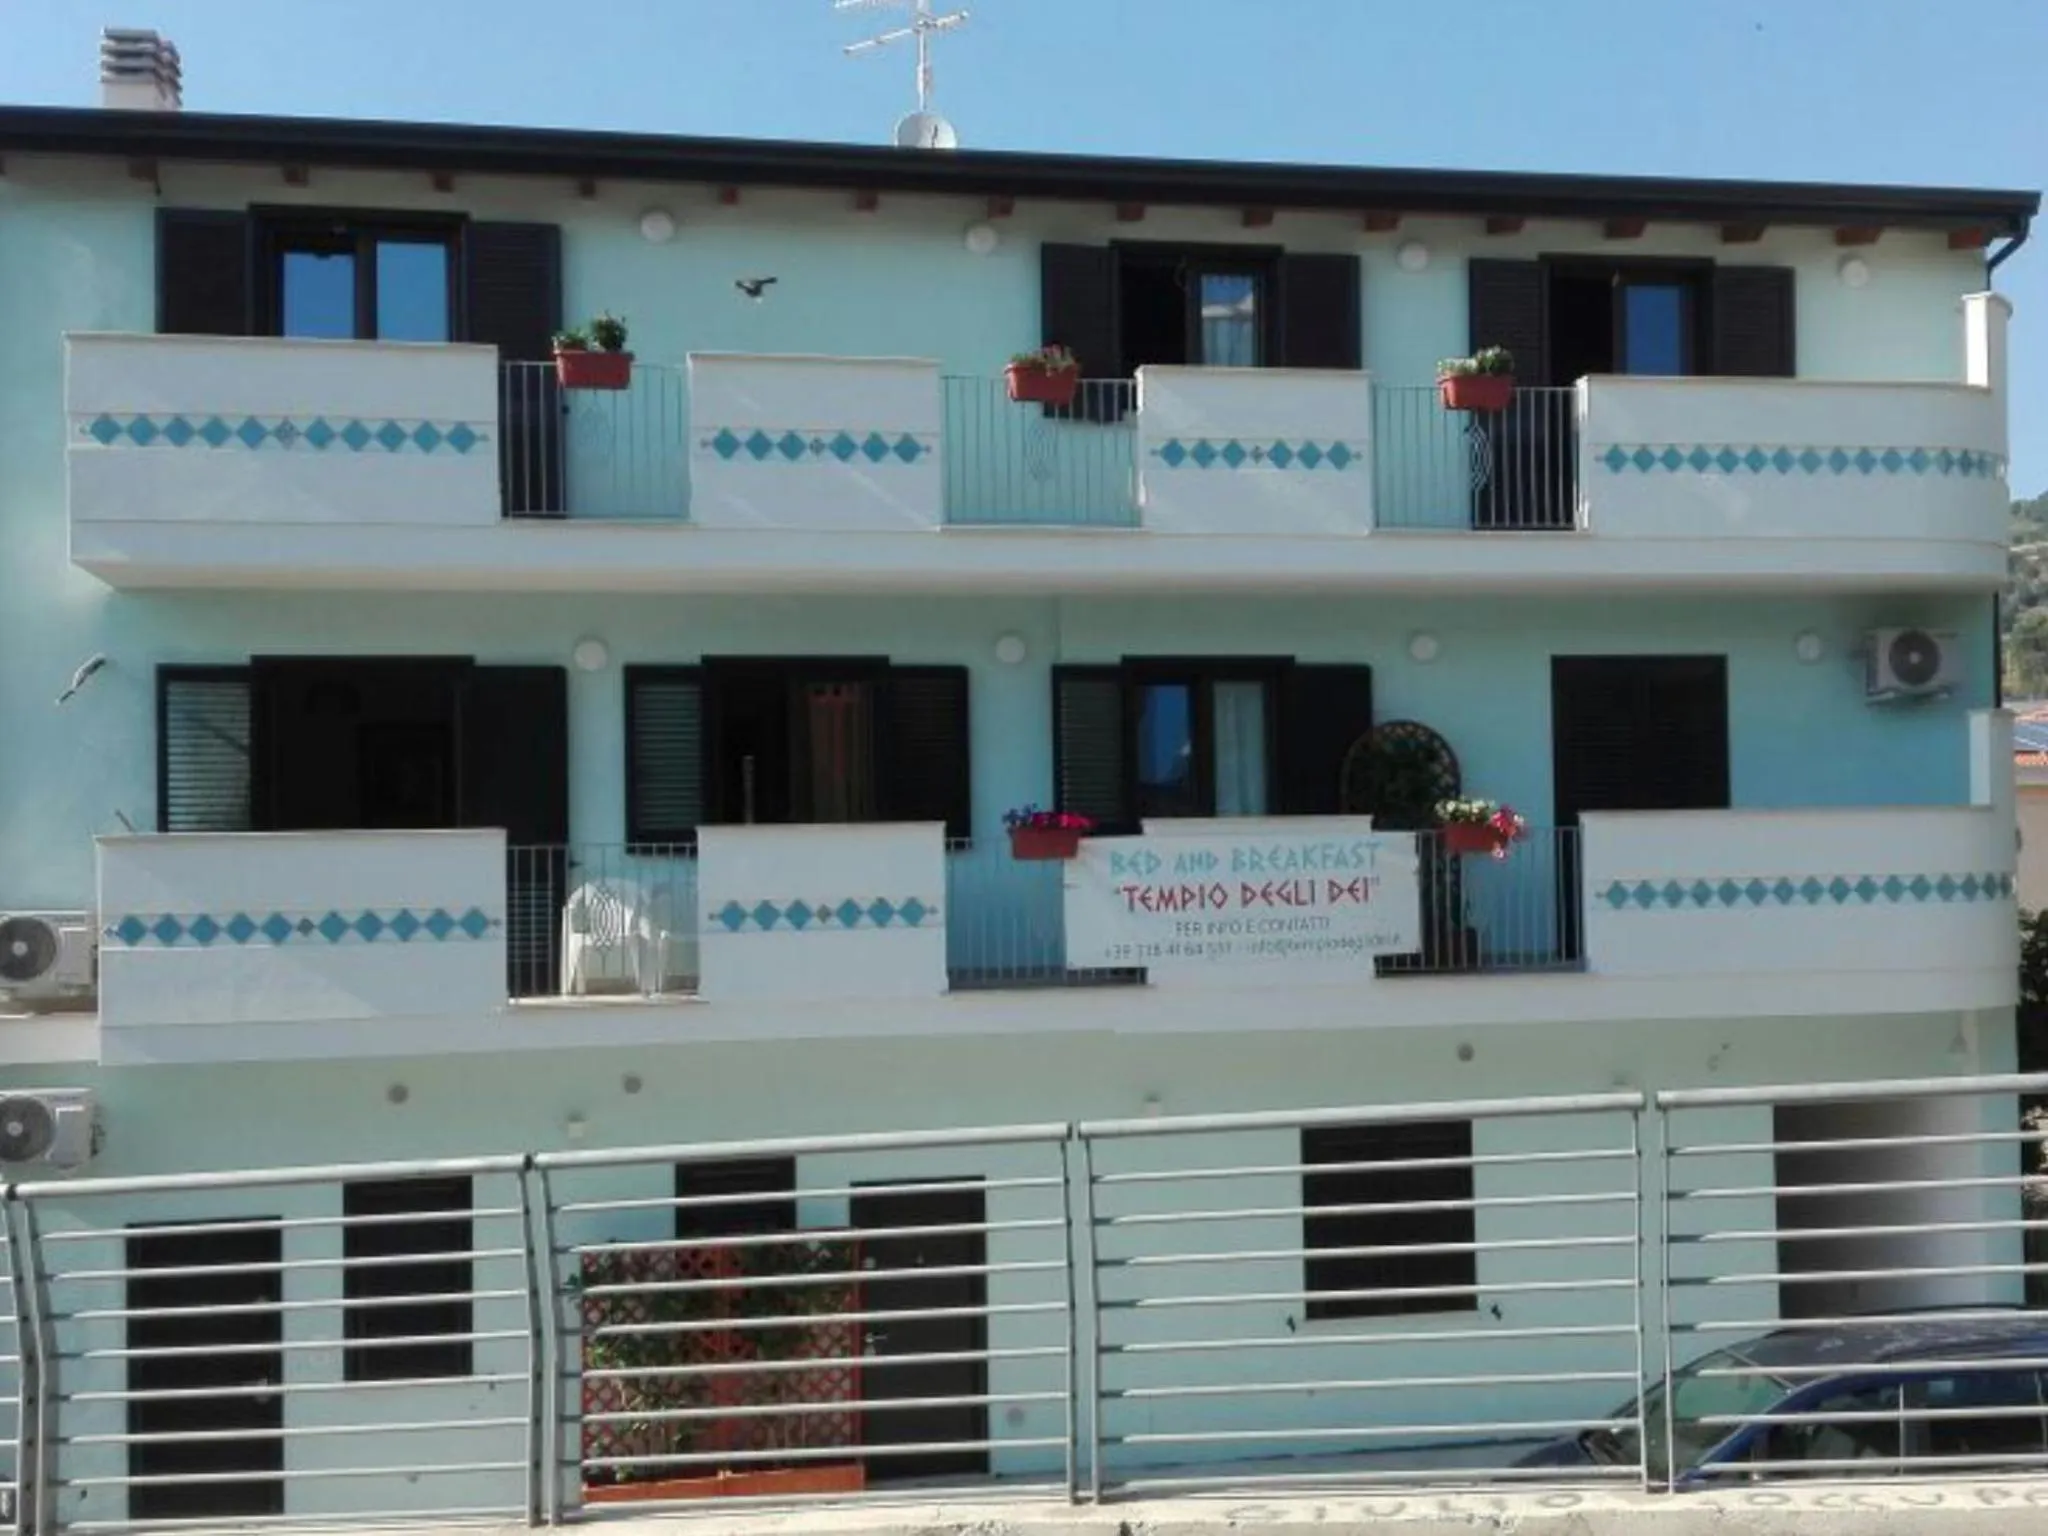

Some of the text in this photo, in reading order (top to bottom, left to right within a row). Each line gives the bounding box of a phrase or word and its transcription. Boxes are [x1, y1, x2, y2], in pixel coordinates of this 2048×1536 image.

[1110, 841, 1382, 877] BED AND BREAKFAST
[1240, 878, 1316, 910] DEGLI
[1326, 875, 1380, 906] DEI"
[1175, 921, 1201, 938] PER
